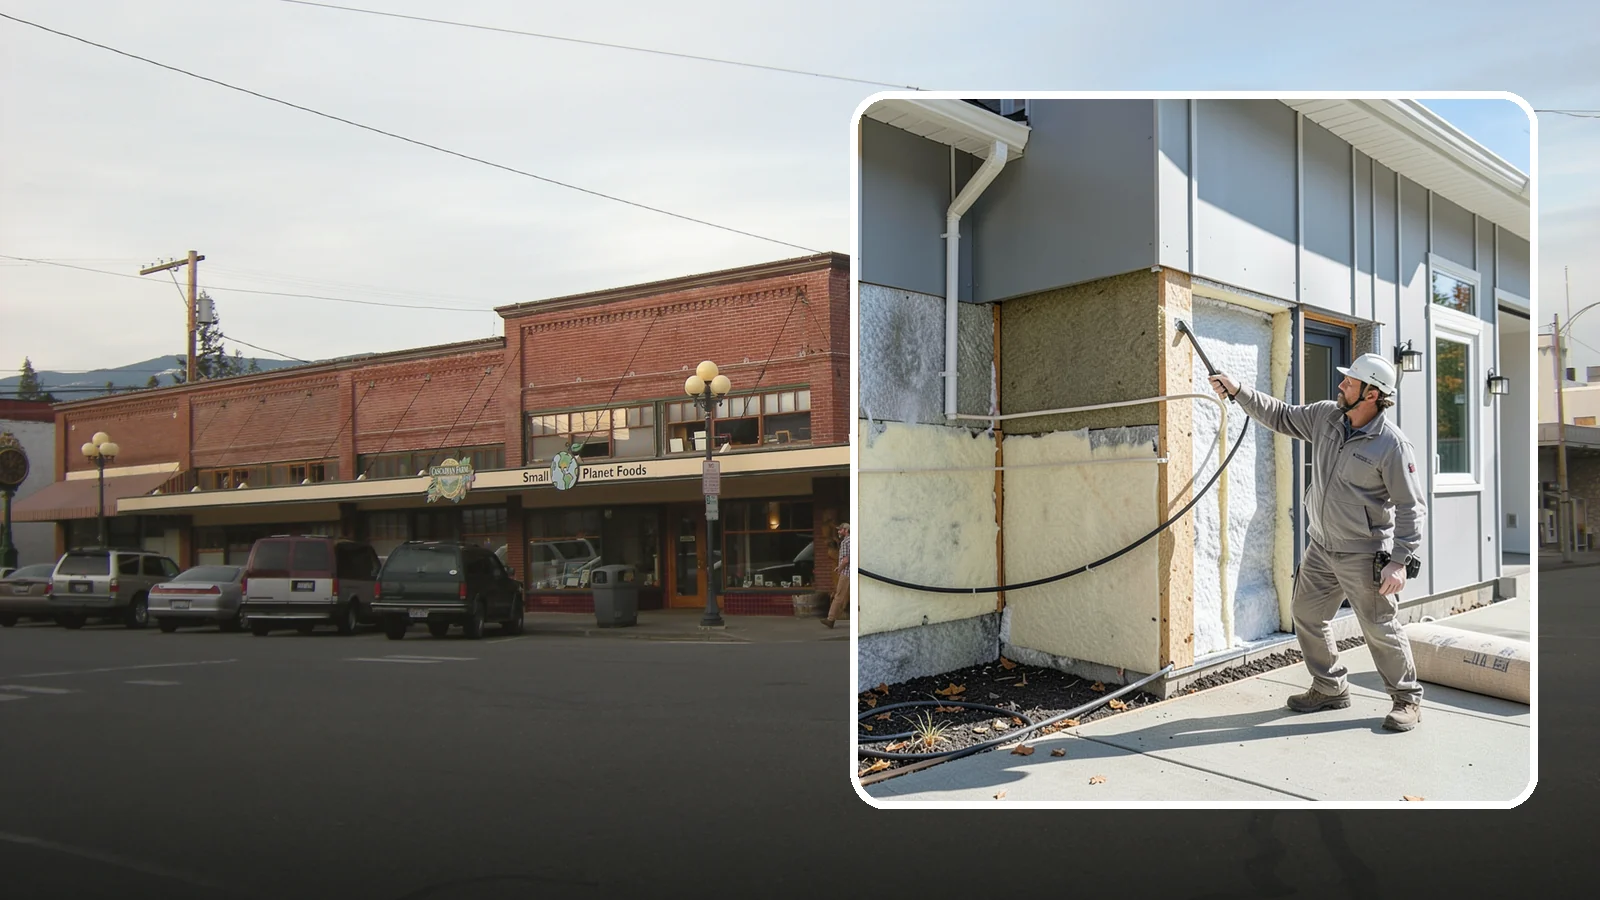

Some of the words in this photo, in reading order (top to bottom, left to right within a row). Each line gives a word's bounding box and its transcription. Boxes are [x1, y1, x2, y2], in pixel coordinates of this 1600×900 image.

[456, 466, 469, 474] FARM
[523, 471, 549, 482] Small
[583, 468, 614, 479] Planet
[617, 465, 647, 476] Foods
